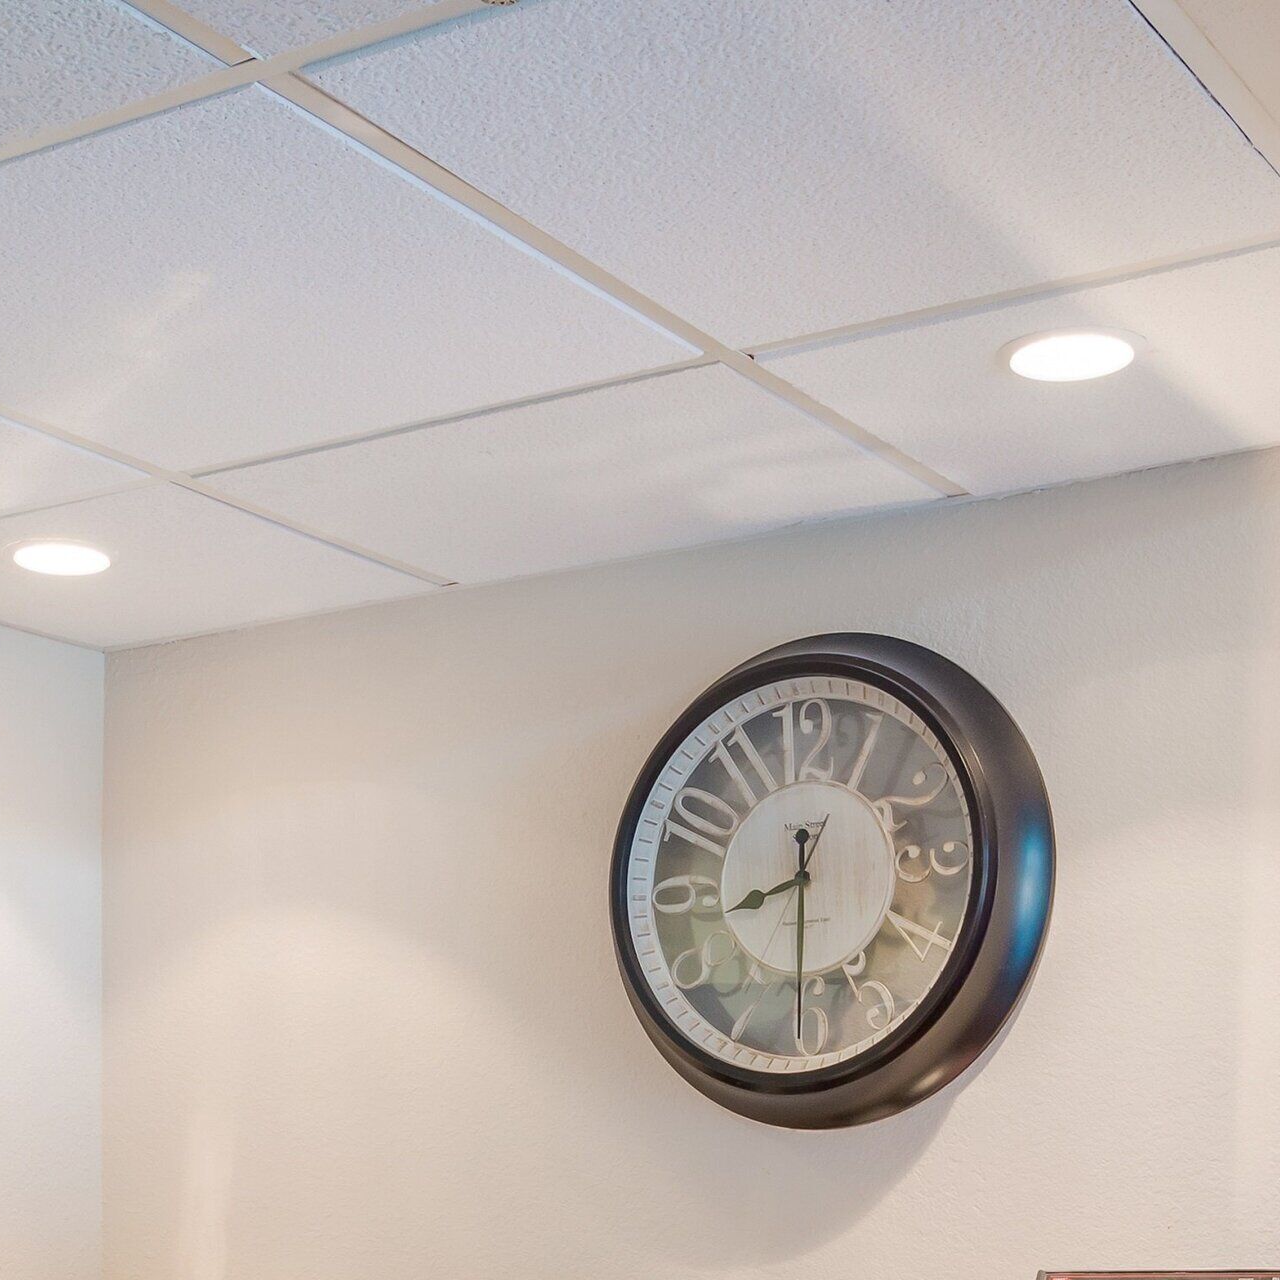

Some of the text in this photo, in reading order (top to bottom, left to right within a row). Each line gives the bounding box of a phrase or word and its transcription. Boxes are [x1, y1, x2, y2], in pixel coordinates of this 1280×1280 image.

[710, 725, 777, 809] 11
[772, 698, 833, 783] 12
[851, 710, 885, 791] 1
[663, 786, 741, 858] 10
[873, 762, 949, 833] 2
[652, 874, 722, 915] 9
[894, 840, 970, 884] 3
[671, 930, 738, 990] 8
[886, 909, 953, 962] 4
[793, 974, 829, 1057] 6
[841, 950, 894, 1031] 5
